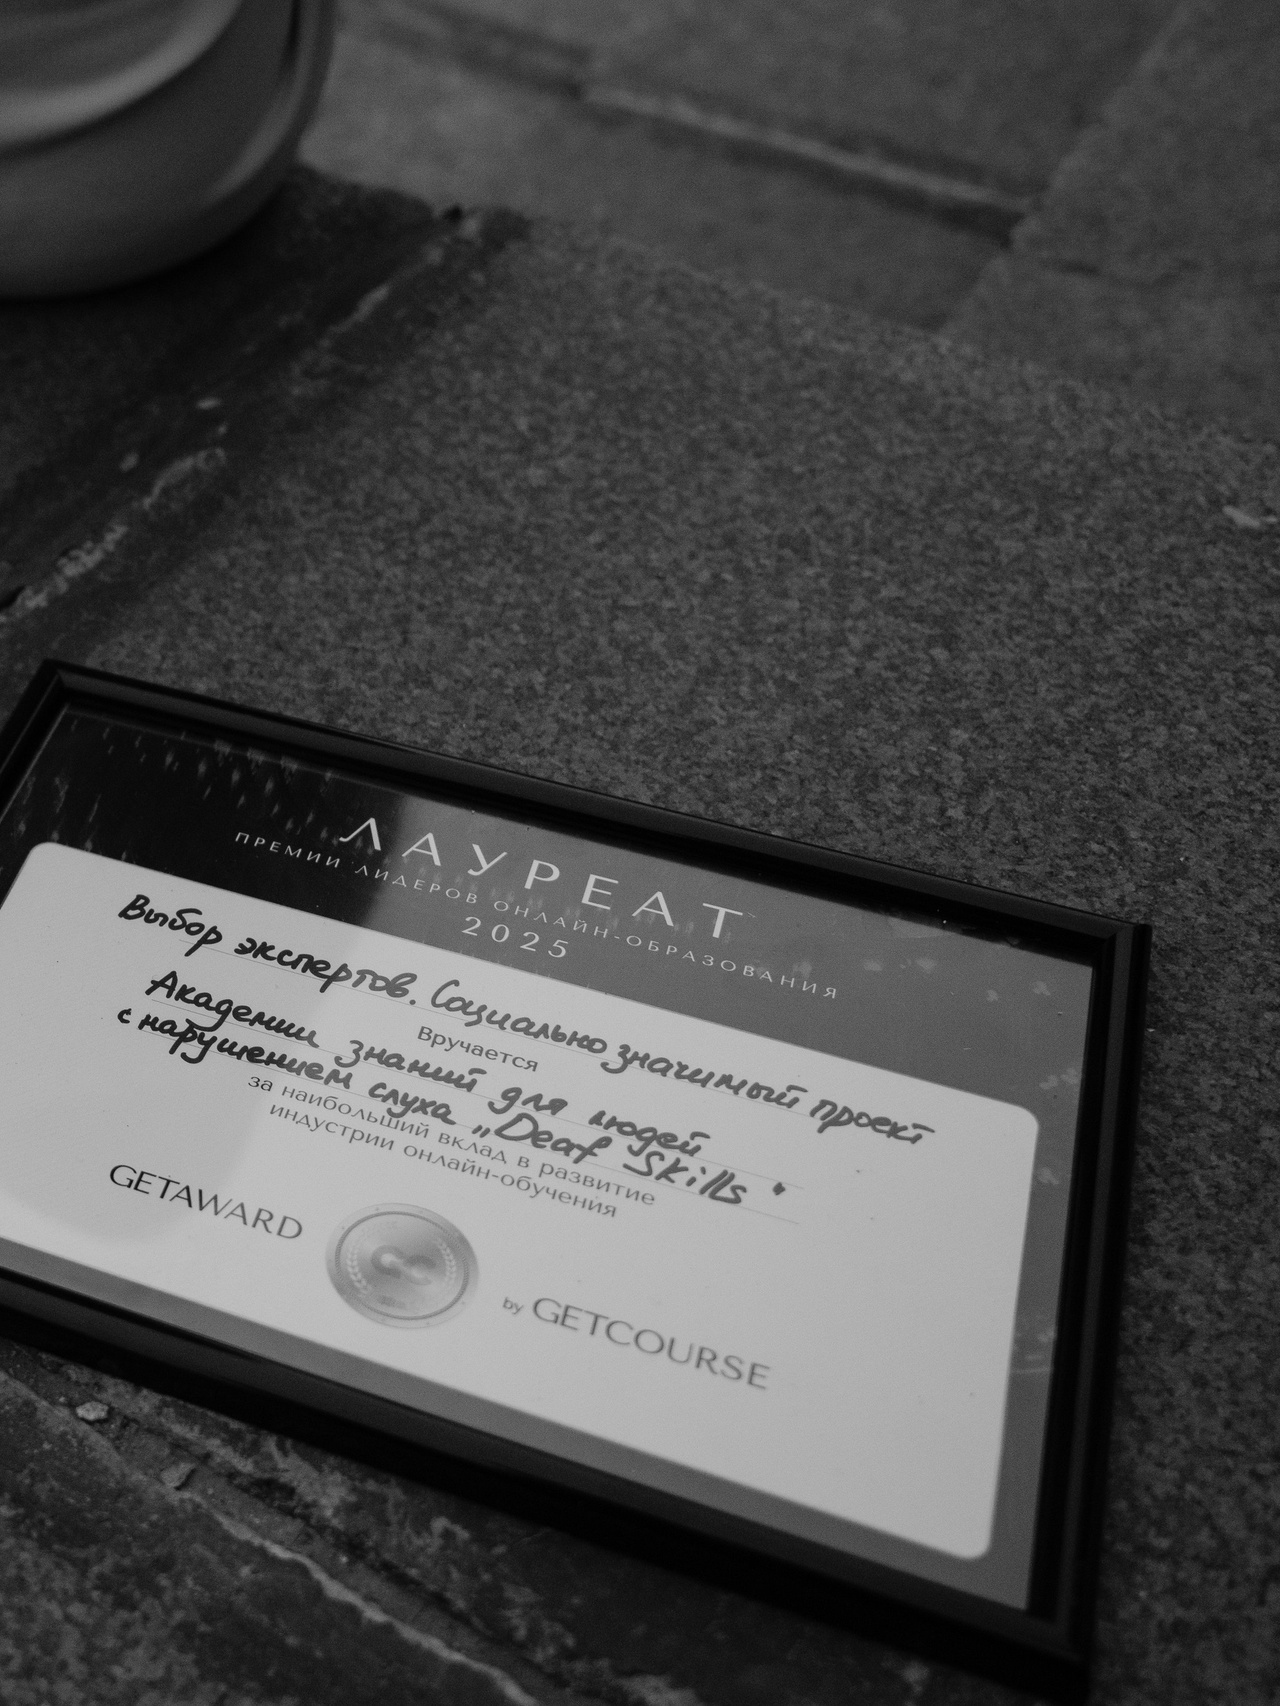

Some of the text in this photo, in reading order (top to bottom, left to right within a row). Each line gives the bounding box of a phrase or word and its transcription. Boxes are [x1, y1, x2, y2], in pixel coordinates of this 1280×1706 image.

[234, 831, 838, 999] ПРЕМИИ ЛИДЕРОВ ОНЛАЙН-ОБРАЗОВАНИЯ
[339, 816, 744, 939] ЛАУРЕАТ
[460, 915, 570, 959] 2025
[117, 1007, 132, 1025] с
[137, 1012, 353, 1090] нарушением
[368, 1081, 457, 1126] слуха
[118, 894, 223, 956] Выбор
[233, 937, 417, 1006] экспертов.
[430, 979, 608, 1054] Социально
[809, 1098, 936, 1145] проект
[416, 1025, 540, 1073] Вручается
[247, 1075, 656, 1206] за наибольший вклад в развитие
[334, 1039, 488, 1093] знаний
[488, 1086, 569, 1116] для
[587, 1109, 711, 1158] людей
[108, 1163, 304, 1240] GETAWARD
[269, 1102, 618, 1219] индустрии онлайн-обучения
[501, 1296, 772, 1391] by GETCOURSE
